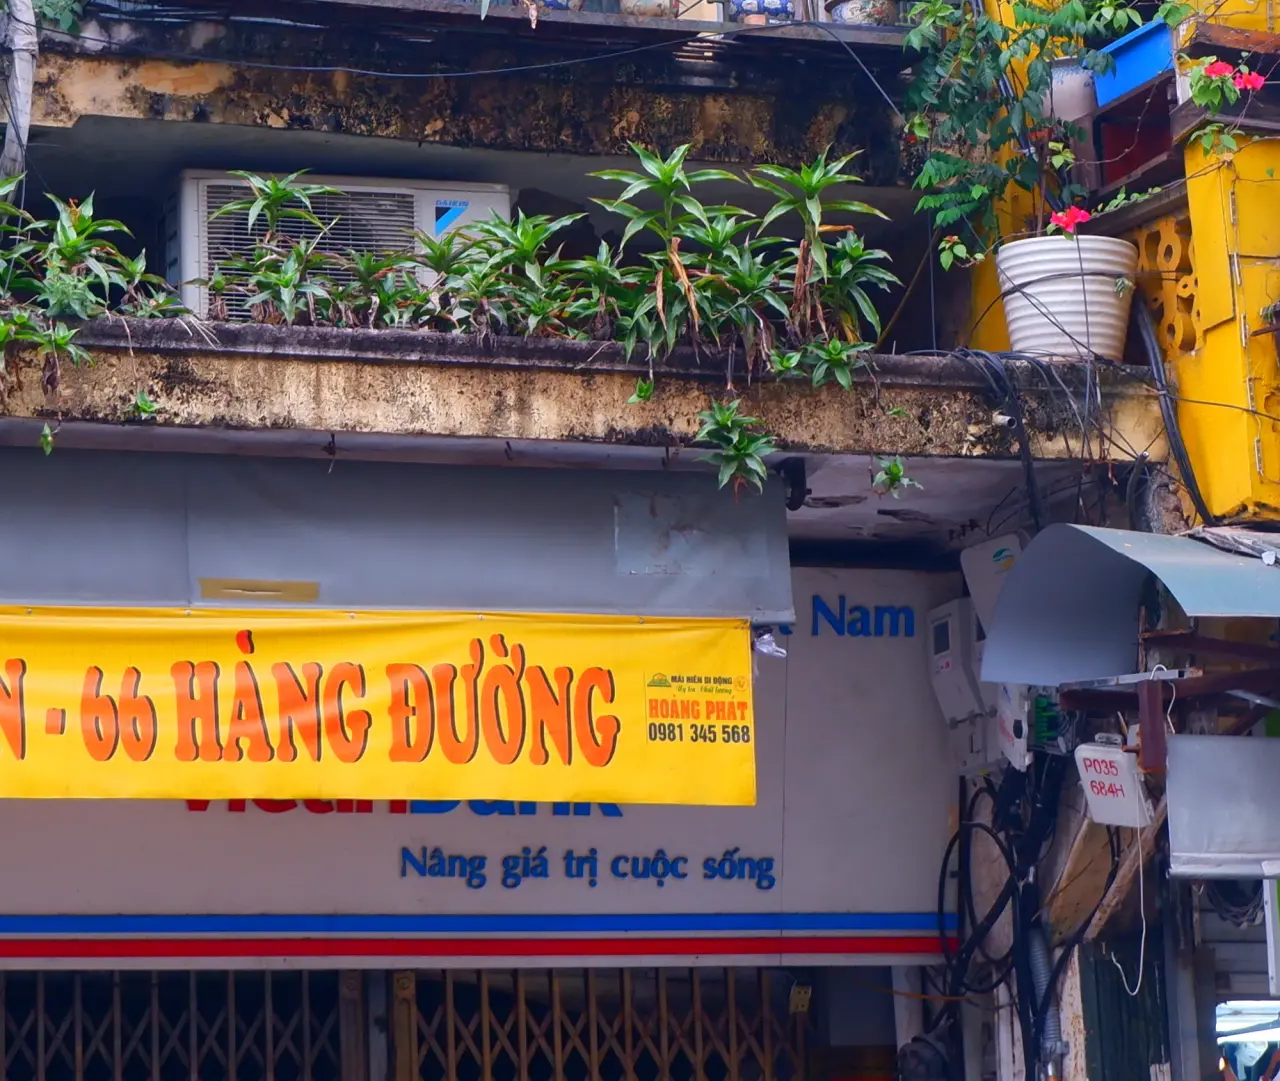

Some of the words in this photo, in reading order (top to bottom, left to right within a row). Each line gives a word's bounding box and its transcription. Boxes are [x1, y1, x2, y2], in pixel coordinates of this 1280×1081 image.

[811, 593, 915, 638] Nam
[81, 665, 158, 762] 66
[170, 629, 373, 763] HÀNG
[385, 633, 621, 768] ĐƯỜNG
[648, 694, 700, 720] HOÀNG
[705, 695, 748, 721] PHÁT
[648, 722, 684, 742] 0981
[690, 723, 717, 743] 345
[721, 724, 750, 743] 568
[1083, 757, 1119, 777] P035
[400, 846, 487, 890] Nâng
[501, 846, 549, 890] giá
[563, 847, 598, 888] trị
[610, 848, 688, 889] cuộc
[703, 846, 776, 891] sống
